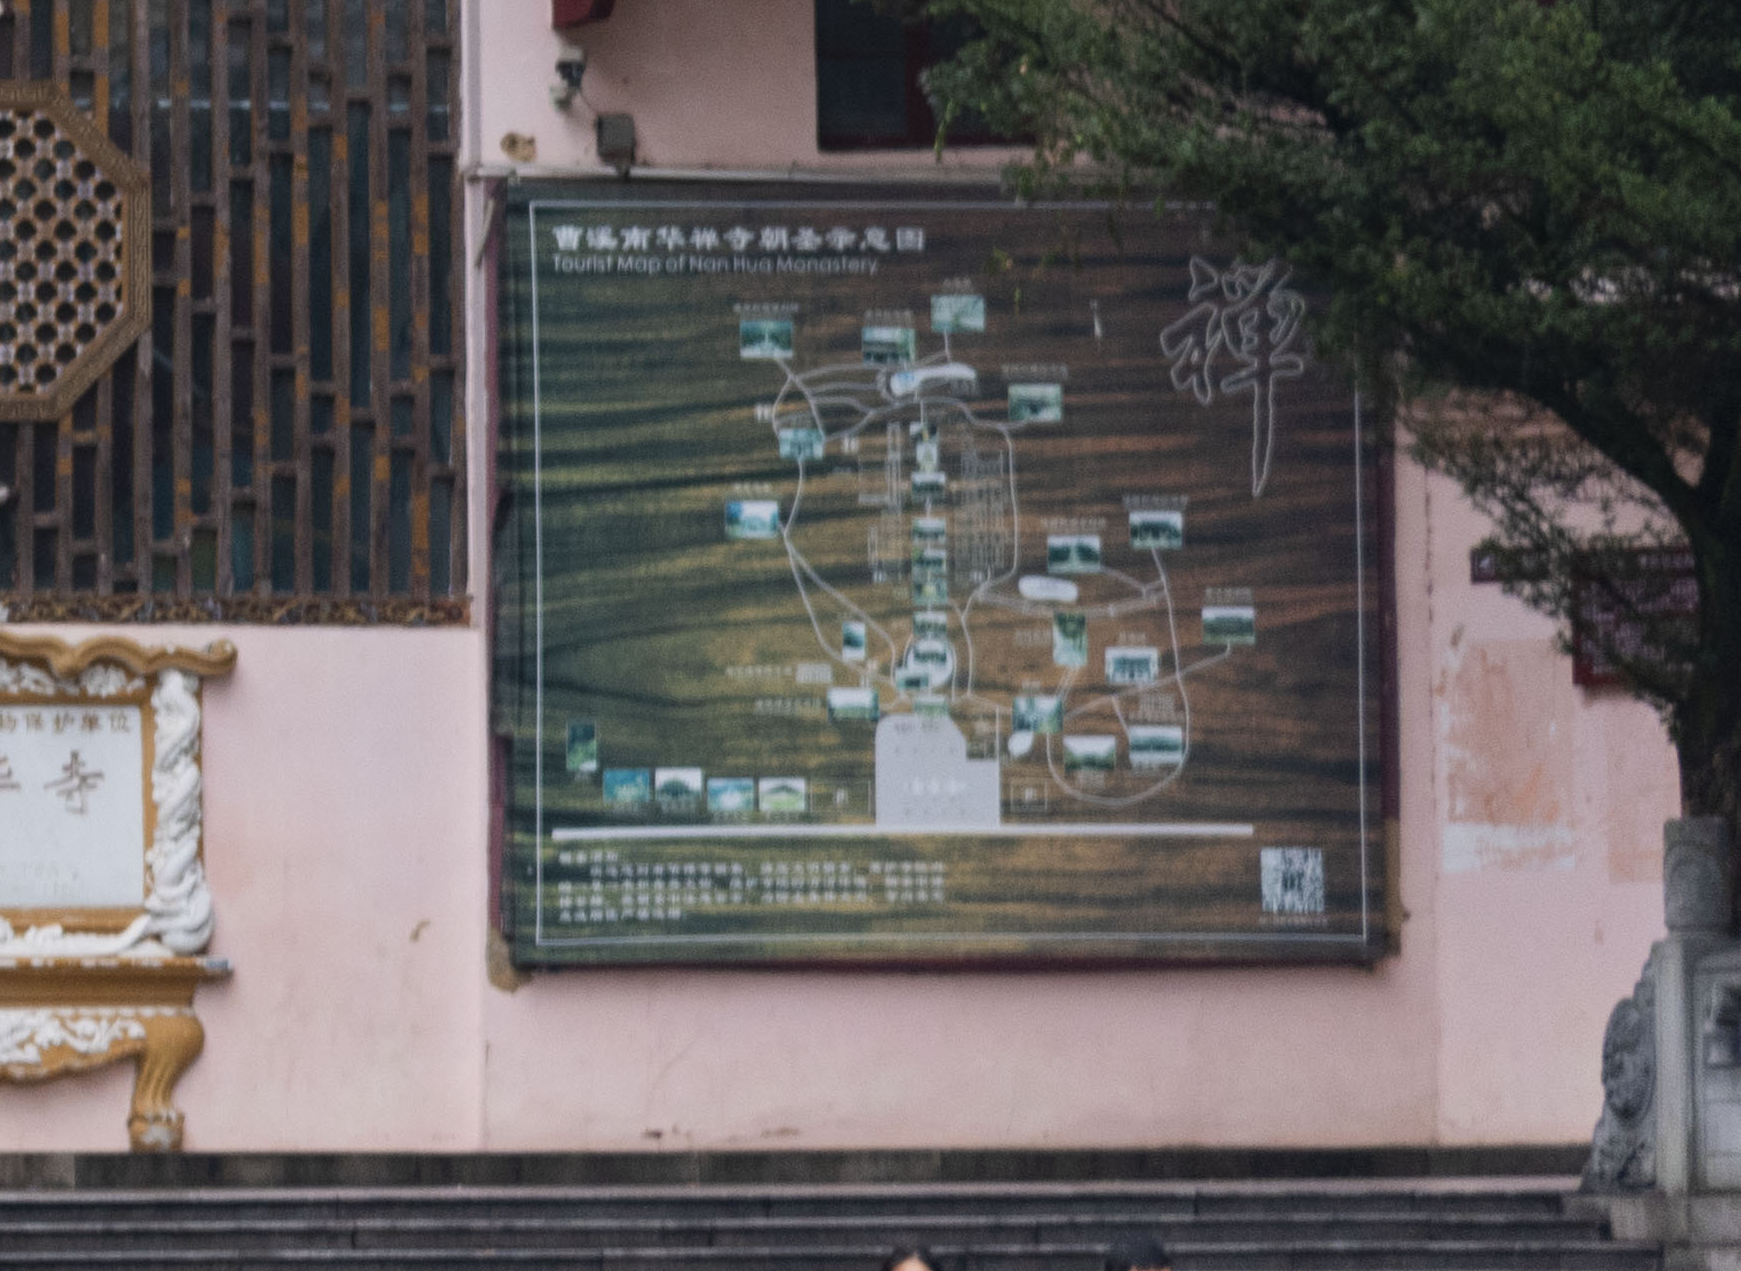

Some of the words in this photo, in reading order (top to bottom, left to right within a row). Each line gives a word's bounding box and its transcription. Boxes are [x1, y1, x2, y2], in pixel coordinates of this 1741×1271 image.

[553, 254, 613, 272] Tourist
[618, 254, 664, 276] Map
[667, 254, 685, 272] of
[689, 255, 731, 272] Nan
[733, 255, 773, 272] Hua
[776, 255, 879, 276] Monastery
